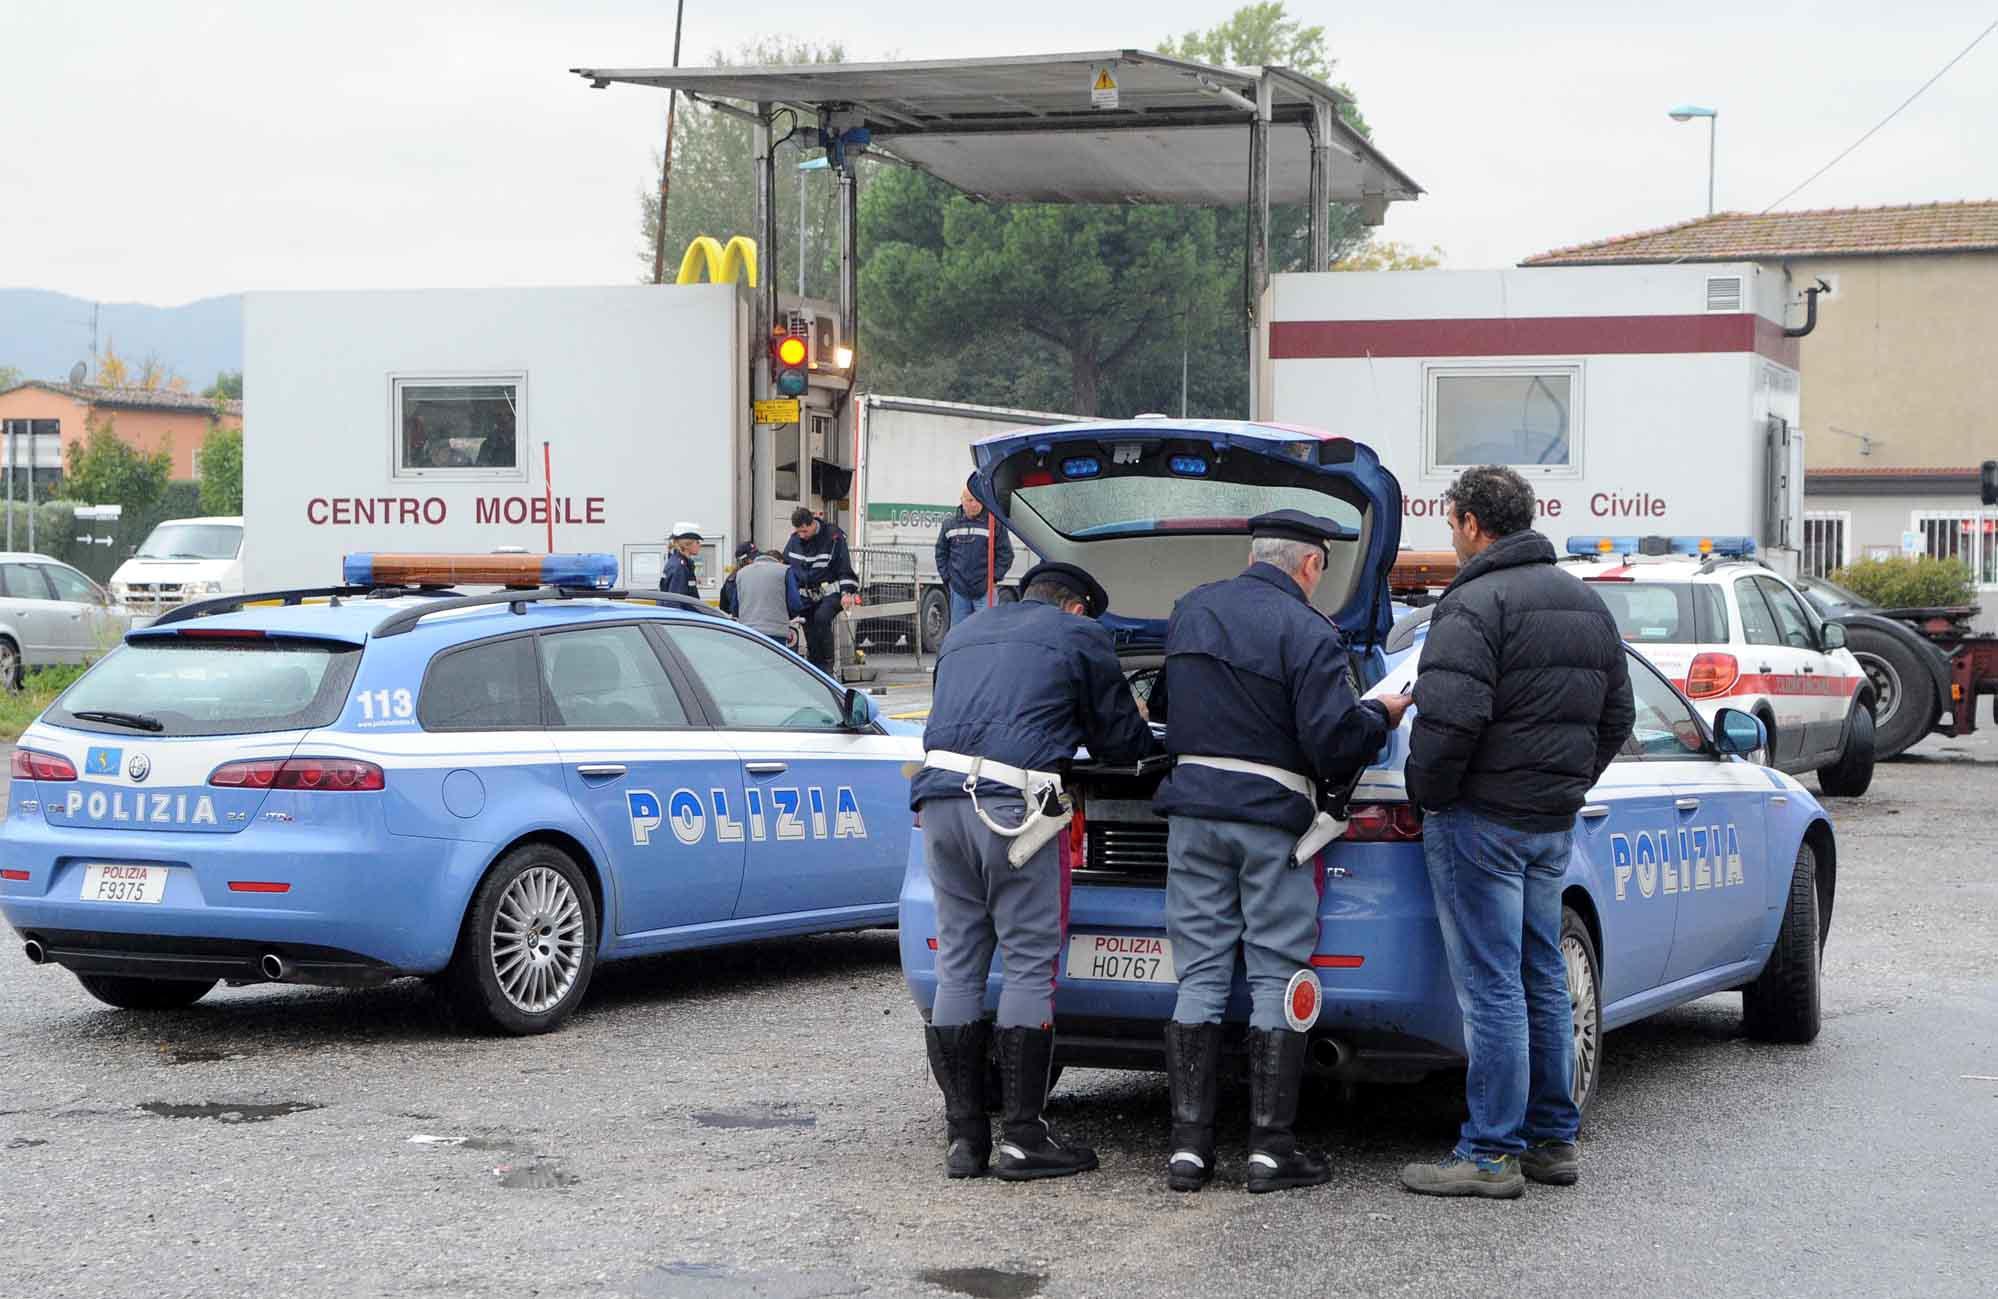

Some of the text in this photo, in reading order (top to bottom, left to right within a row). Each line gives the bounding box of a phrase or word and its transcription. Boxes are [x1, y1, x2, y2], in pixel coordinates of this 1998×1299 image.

[307, 496, 606, 525] CENTRO MOBILE
[1402, 492, 1667, 517] tori ne Civile
[891, 509, 953, 528] LOGISTIC
[356, 688, 413, 719] 113
[65, 790, 218, 825] POLIZIA
[625, 786, 868, 846] POLIZIA
[102, 866, 148, 880] POLIZIA
[1610, 823, 1745, 901] POLIZIA
[97, 881, 145, 901] F9375
[1095, 937, 1163, 955] POLIZIA
[1092, 956, 1161, 980] H0767
